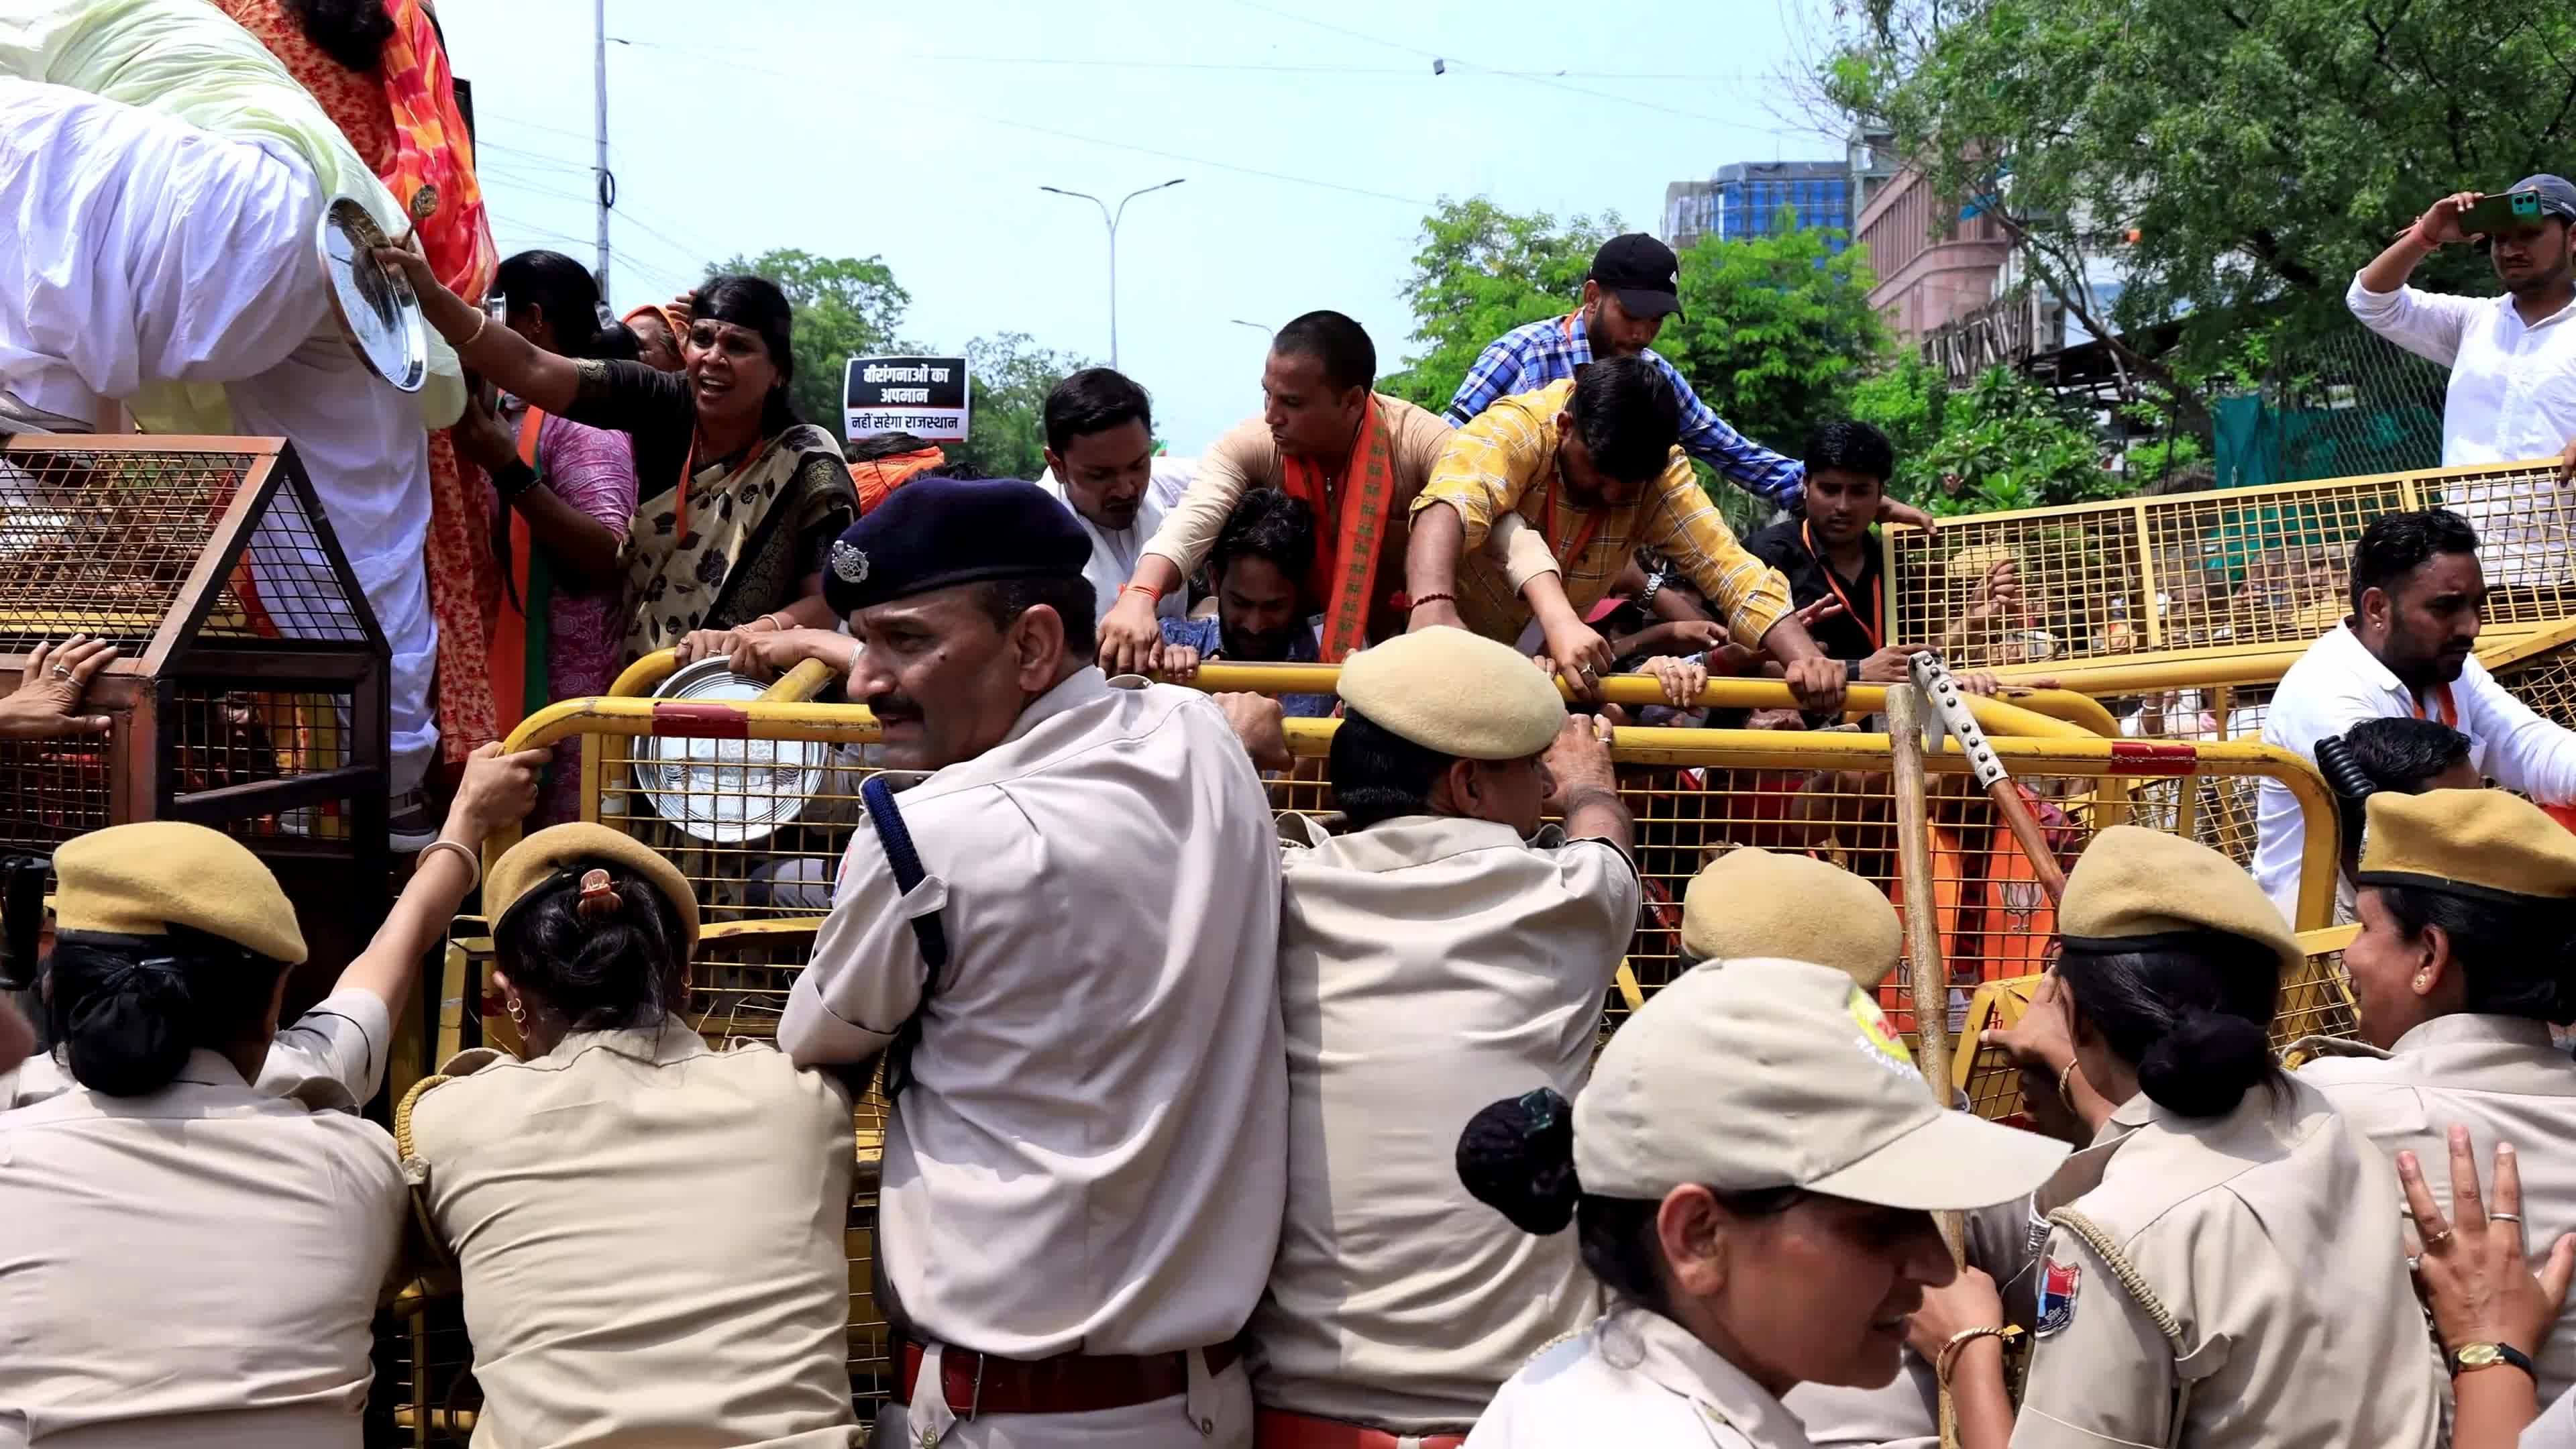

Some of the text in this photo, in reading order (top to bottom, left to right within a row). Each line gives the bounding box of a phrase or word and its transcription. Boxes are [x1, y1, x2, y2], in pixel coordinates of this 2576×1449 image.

[863, 364, 950, 383] वीरांगनाओं का
[880, 388, 930, 402] अपमान
[851, 413, 959, 429] नहीं सहेगा राजस्थान
